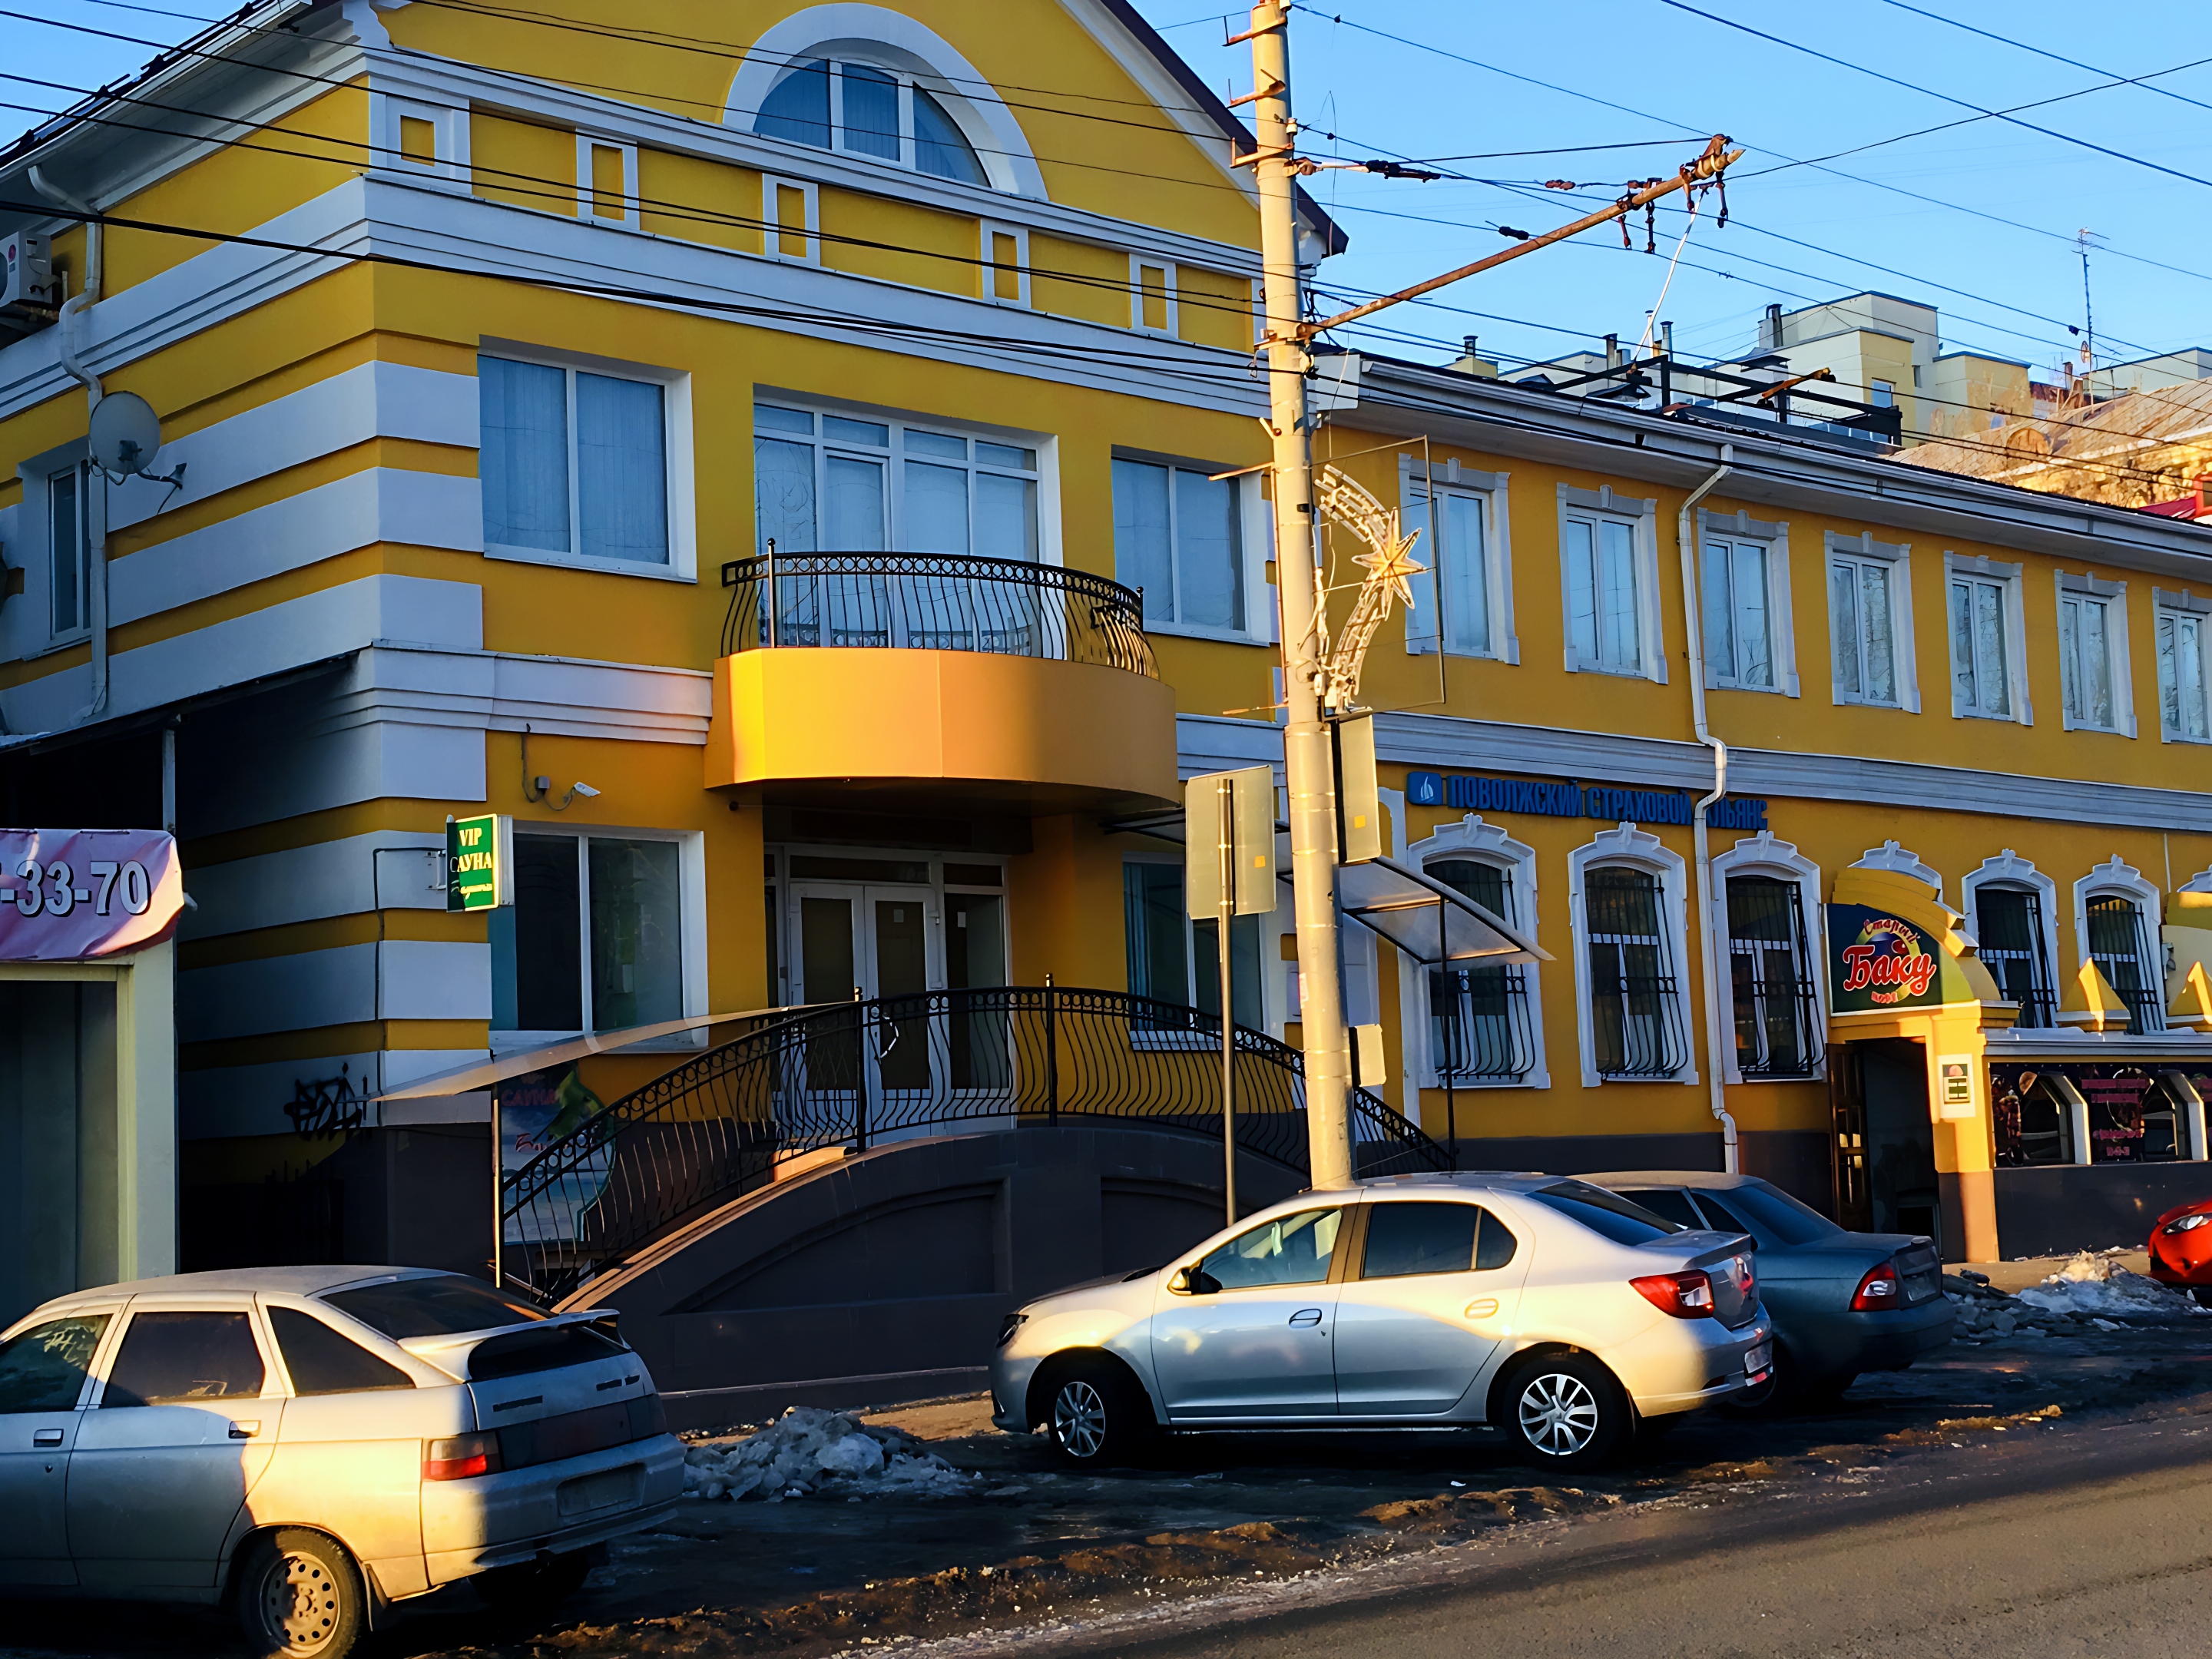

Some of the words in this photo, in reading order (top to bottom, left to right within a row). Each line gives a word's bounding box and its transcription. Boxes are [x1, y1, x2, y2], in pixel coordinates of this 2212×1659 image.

[1448, 775, 1582, 817] ПОВОЛЖСКИЙ
[1586, 787, 1692, 825] СТРАХОВОЙ
[459, 827, 482, 846] VIP
[0, 859, 151, 917] -33-70
[1843, 945, 1937, 996] Баку
